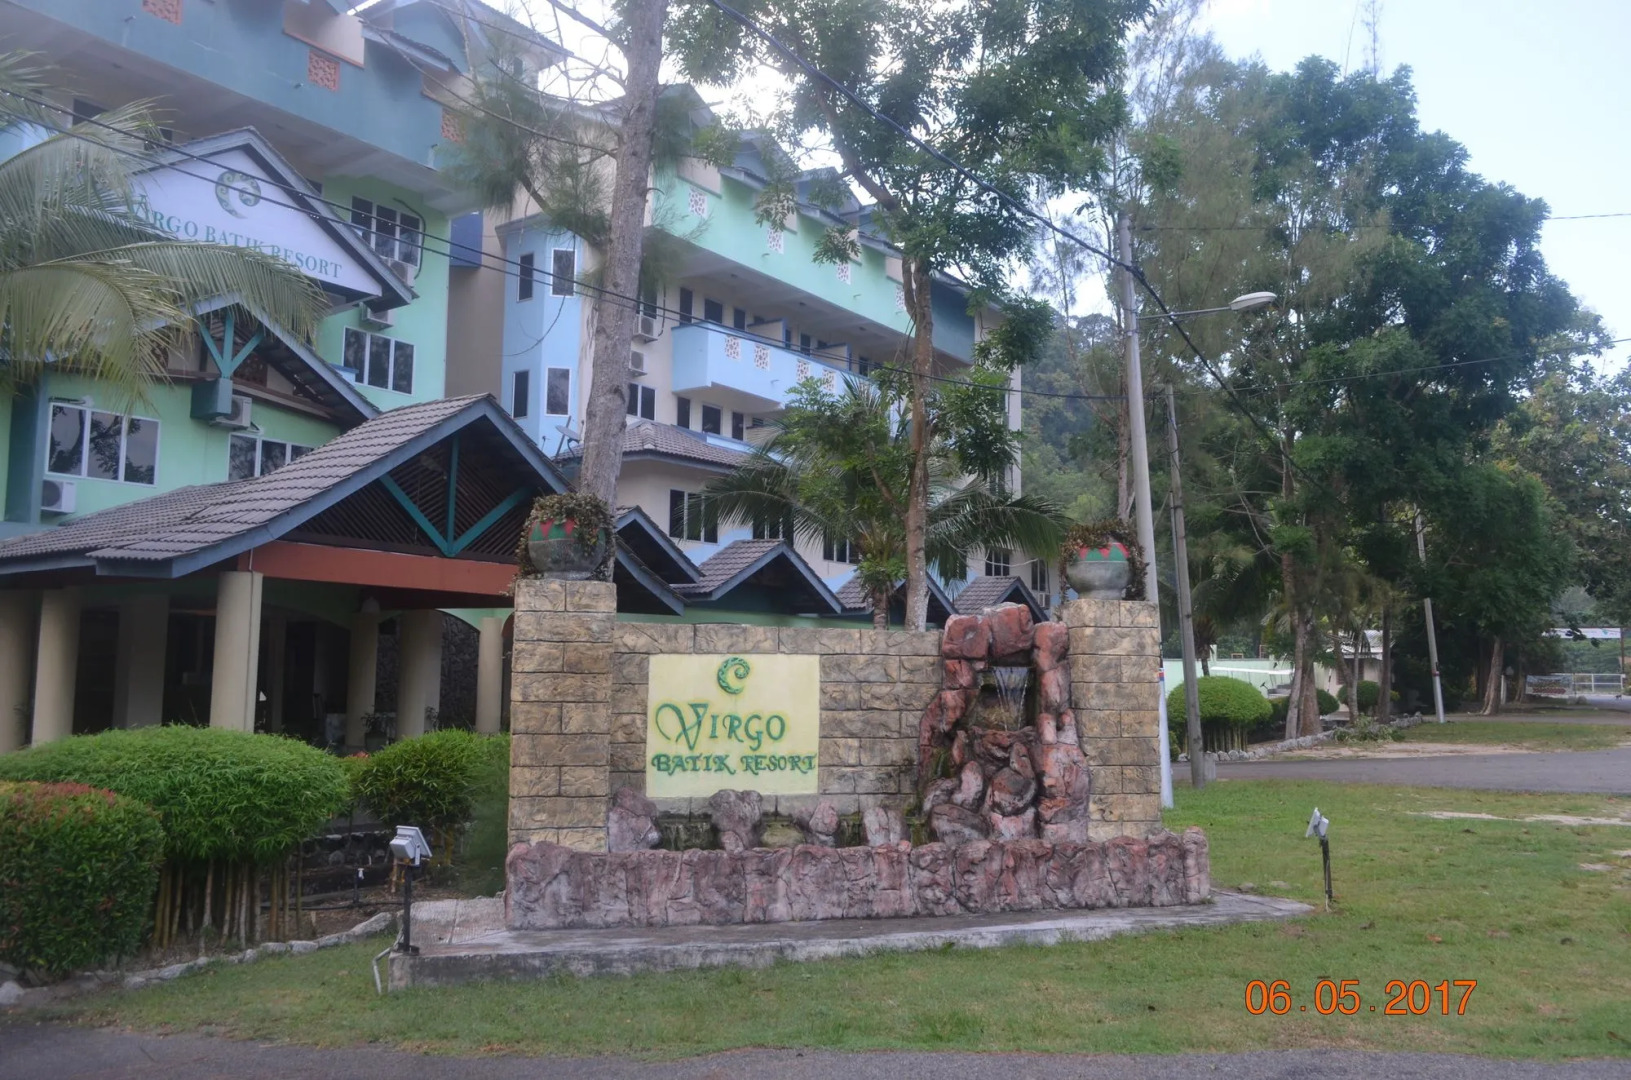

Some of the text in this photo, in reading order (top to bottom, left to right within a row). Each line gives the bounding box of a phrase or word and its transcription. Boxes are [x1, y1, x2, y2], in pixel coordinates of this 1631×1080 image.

[205, 225, 265, 253] BATIK
[270, 244, 343, 279] RESORT
[654, 702, 786, 752] VIRGO
[650, 752, 818, 777] BATIK RESORT
